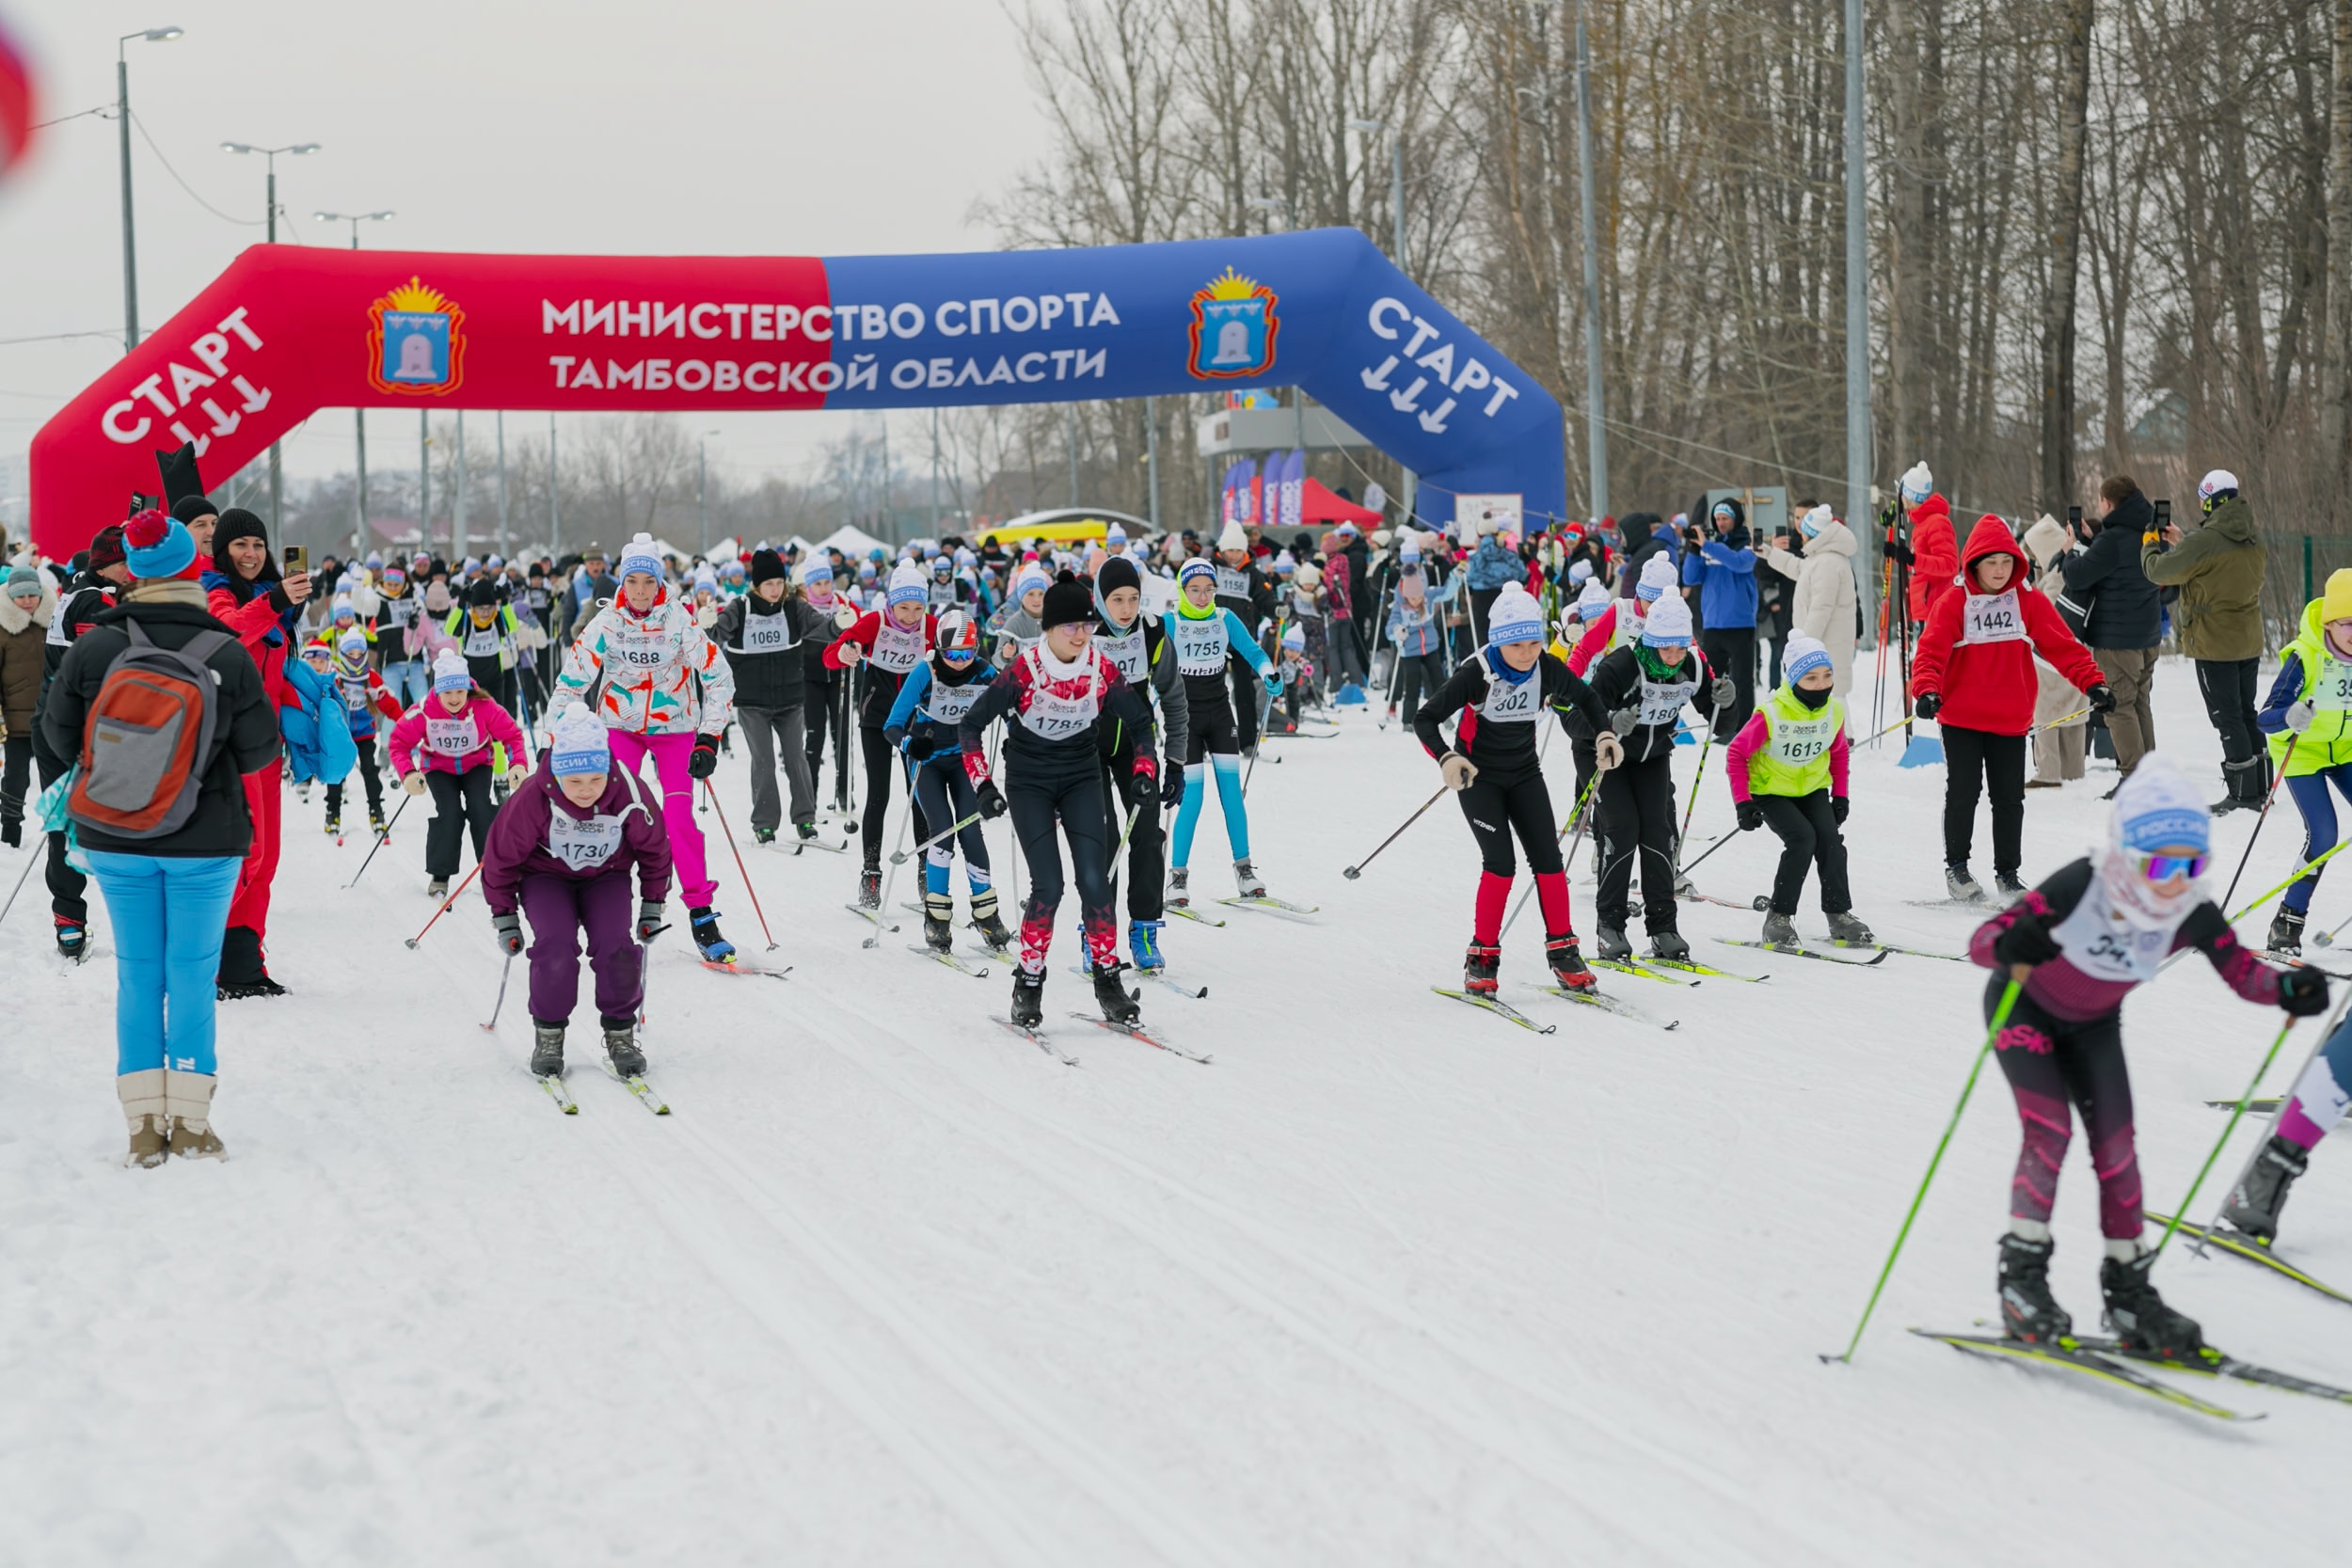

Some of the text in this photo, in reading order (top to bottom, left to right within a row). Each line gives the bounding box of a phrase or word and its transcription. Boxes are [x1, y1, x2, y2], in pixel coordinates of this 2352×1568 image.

[542, 292, 1120, 341] МИНИСТЕРСТВО СПОРТА
[1368, 296, 1519, 418] СТАРТ
[101, 306, 263, 444] СТАРТ
[549, 348, 1107, 393] ТАМБОВСКОЙ ОБЛАСТИ
[1224, 578, 1244, 592] 1156
[1974, 611, 2012, 631] 1442
[751, 630, 781, 645] 1069
[1498, 626, 1538, 640] РОССИИ
[882, 648, 916, 666] 1742
[1184, 641, 1220, 657] 1755
[1790, 654, 1822, 678] РОССИИ
[437, 736, 469, 749] 1979
[1783, 741, 1822, 757] 1613
[553, 758, 588, 770] ОССИИ
[562, 843, 609, 860] 1730
